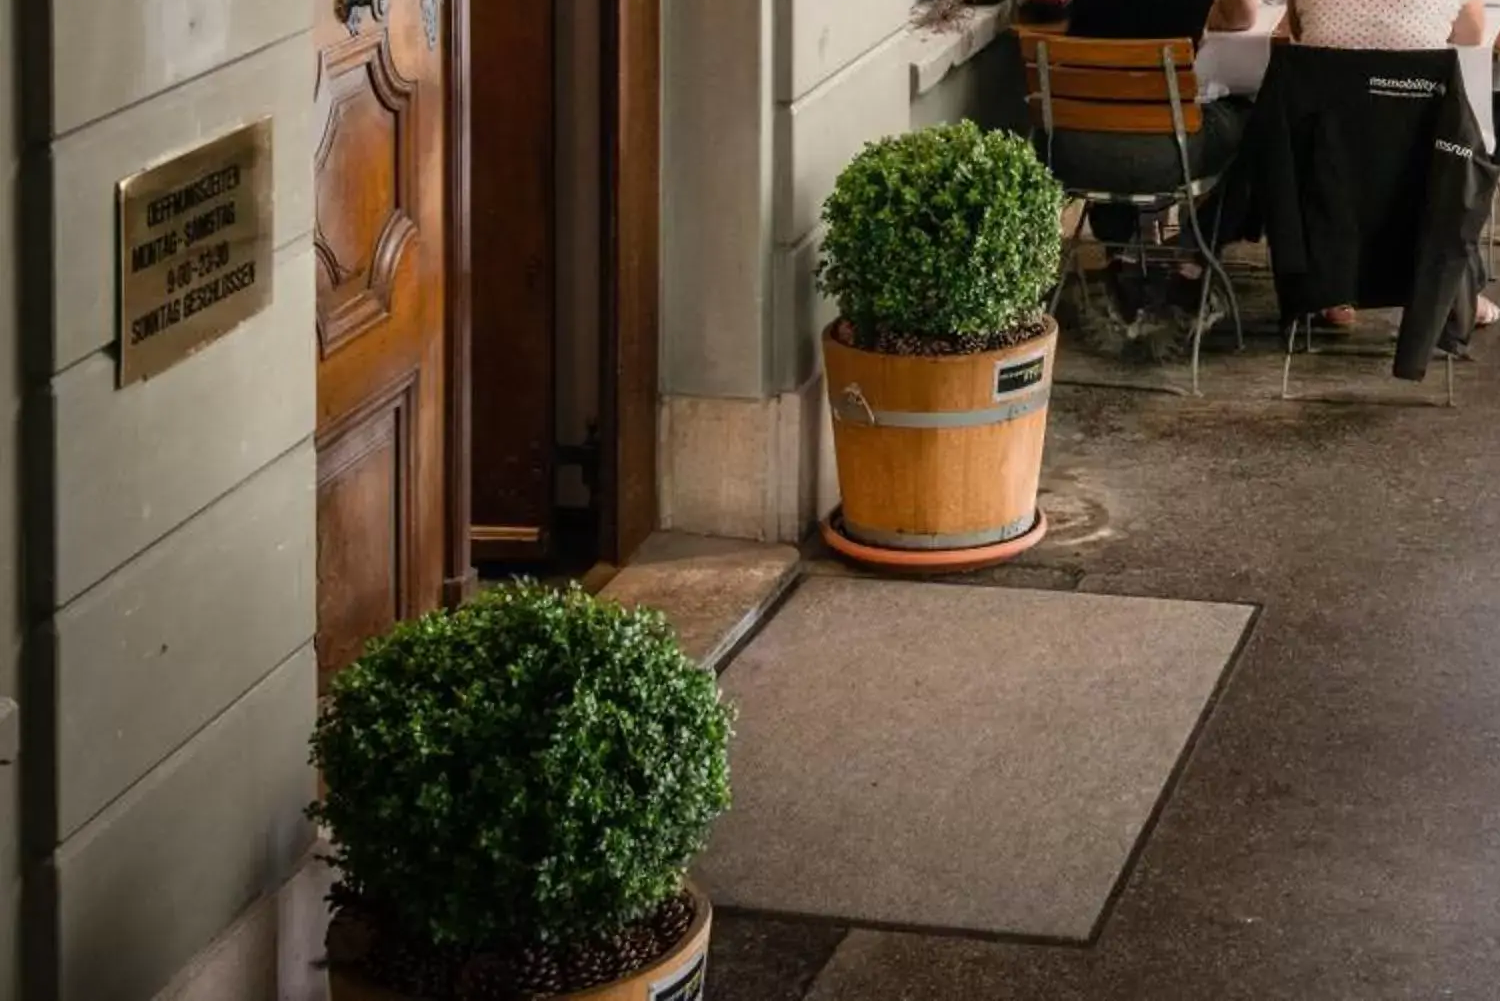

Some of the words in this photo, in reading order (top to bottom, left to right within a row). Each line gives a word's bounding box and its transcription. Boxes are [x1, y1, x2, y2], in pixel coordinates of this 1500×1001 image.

[1369, 77, 1437, 92] msmobility
[130, 298, 181, 345] SONNTAG
[183, 260, 256, 317] GESCHLOSSEN
